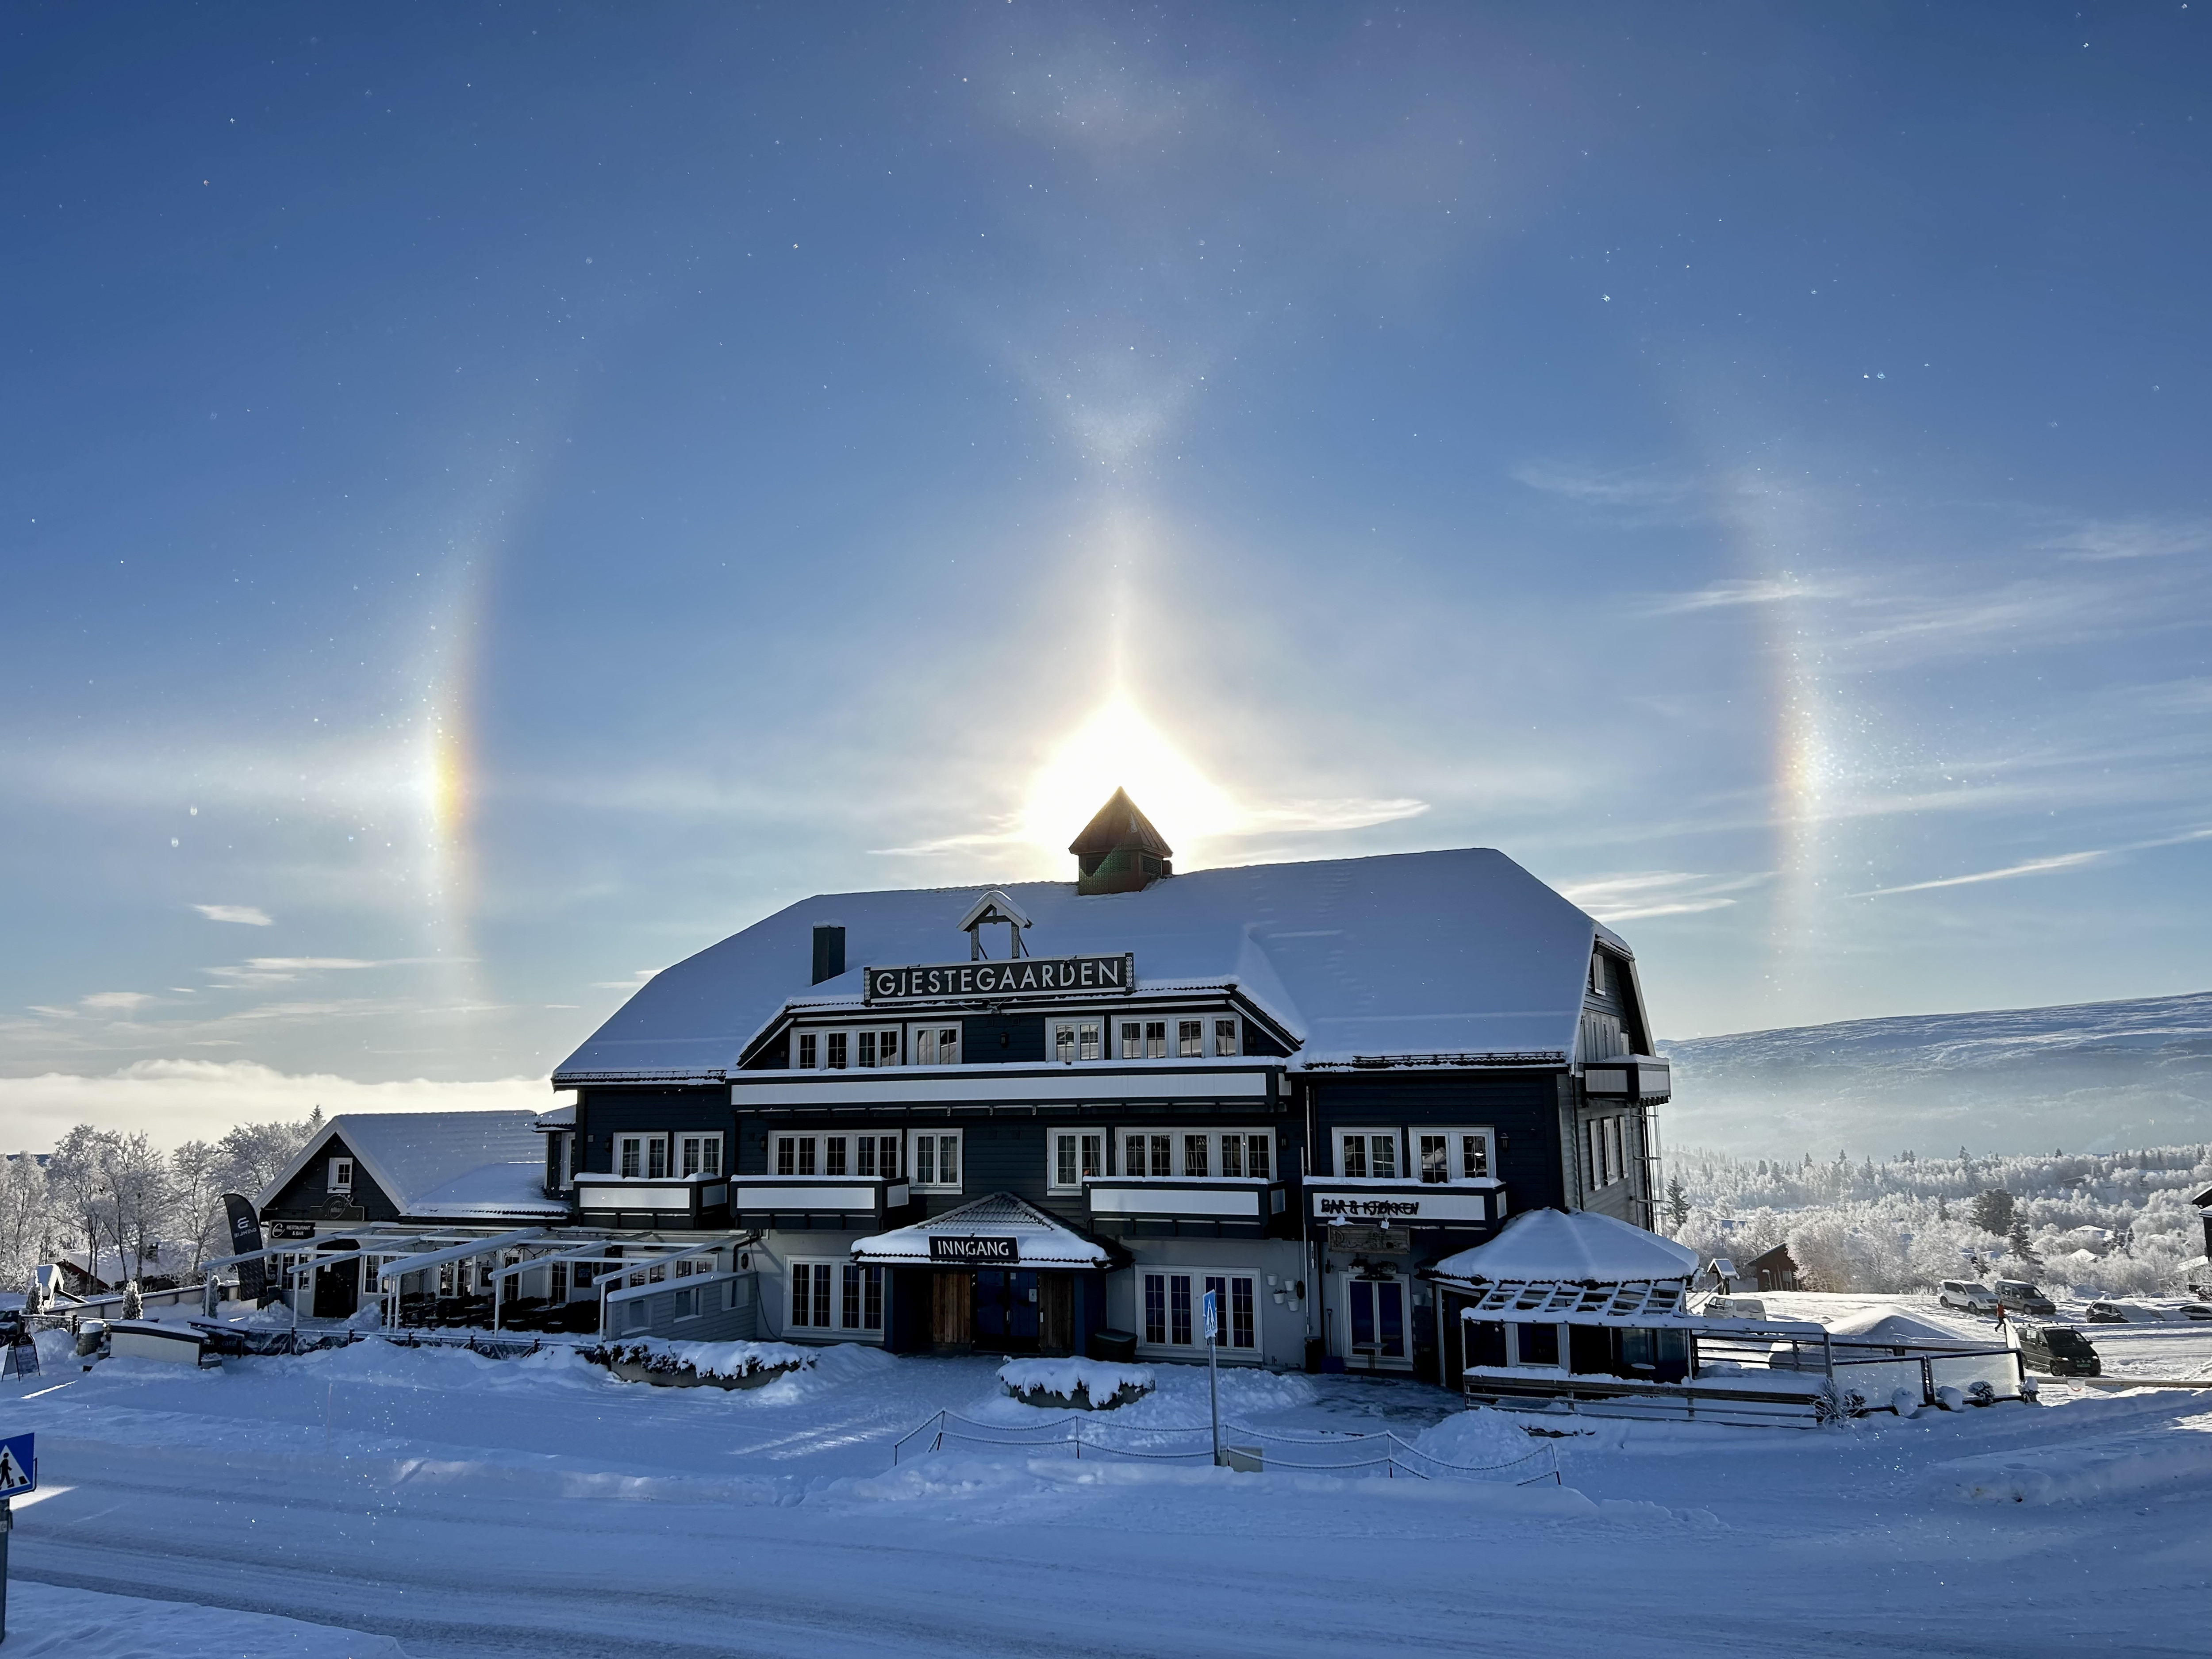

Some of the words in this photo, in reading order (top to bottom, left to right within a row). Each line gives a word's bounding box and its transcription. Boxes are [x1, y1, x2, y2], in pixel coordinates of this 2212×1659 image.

[876, 960, 1118, 996] GJESTEGAARDEN
[1321, 1198, 1347, 1214] BAR
[1363, 1200, 1419, 1216] KJØKKEN
[937, 1240, 1009, 1256] INNGANG
